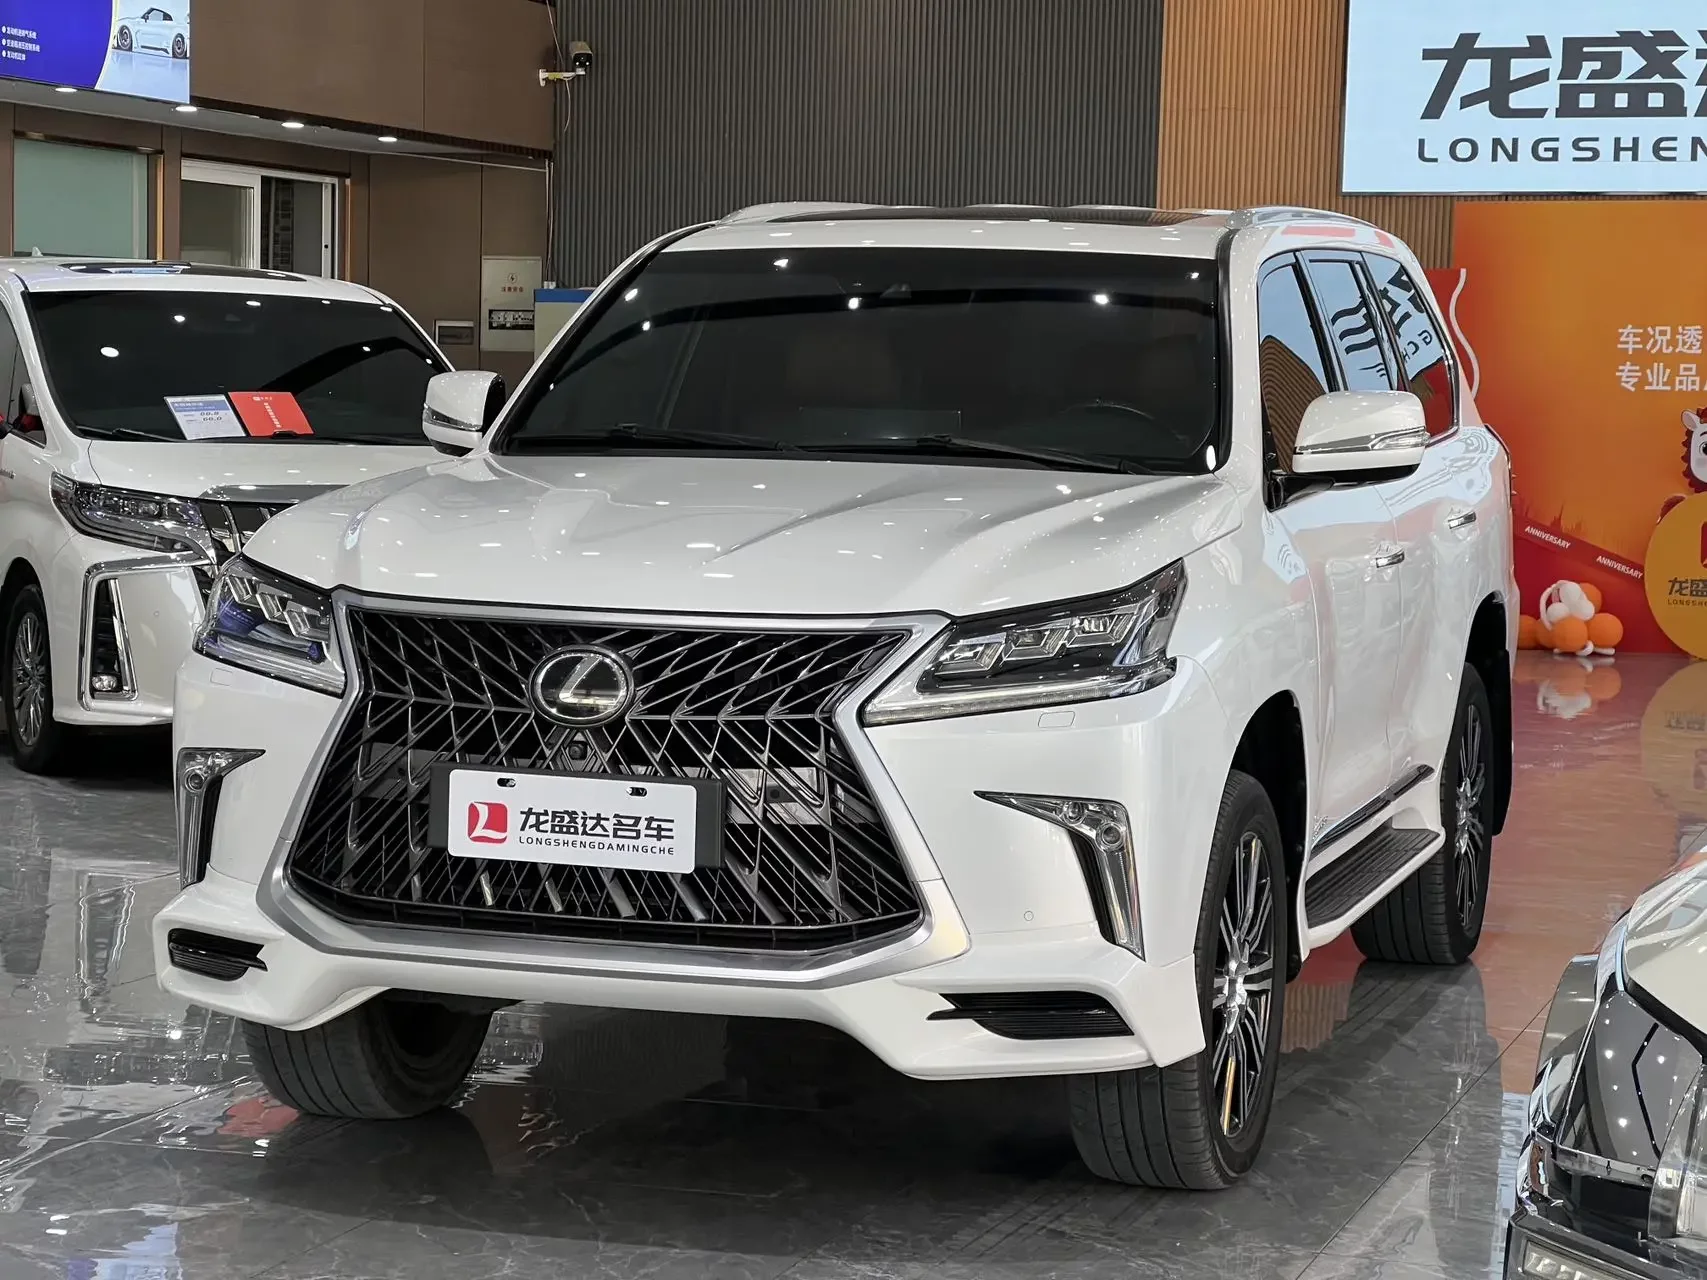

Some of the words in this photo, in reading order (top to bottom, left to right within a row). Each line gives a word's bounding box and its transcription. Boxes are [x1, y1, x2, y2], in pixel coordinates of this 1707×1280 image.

[1420, 30, 1707, 120] 龙盛
[1616, 324, 1703, 355] 车况透
[1615, 361, 1707, 392] 专业品
[1524, 525, 1571, 549] ANNIVERSARY
[1596, 555, 1643, 580] ANNIVERSARY
[519, 807, 675, 842] 龙盛达名车
[519, 836, 675, 856] LONGSHENGDAMINGCHE
